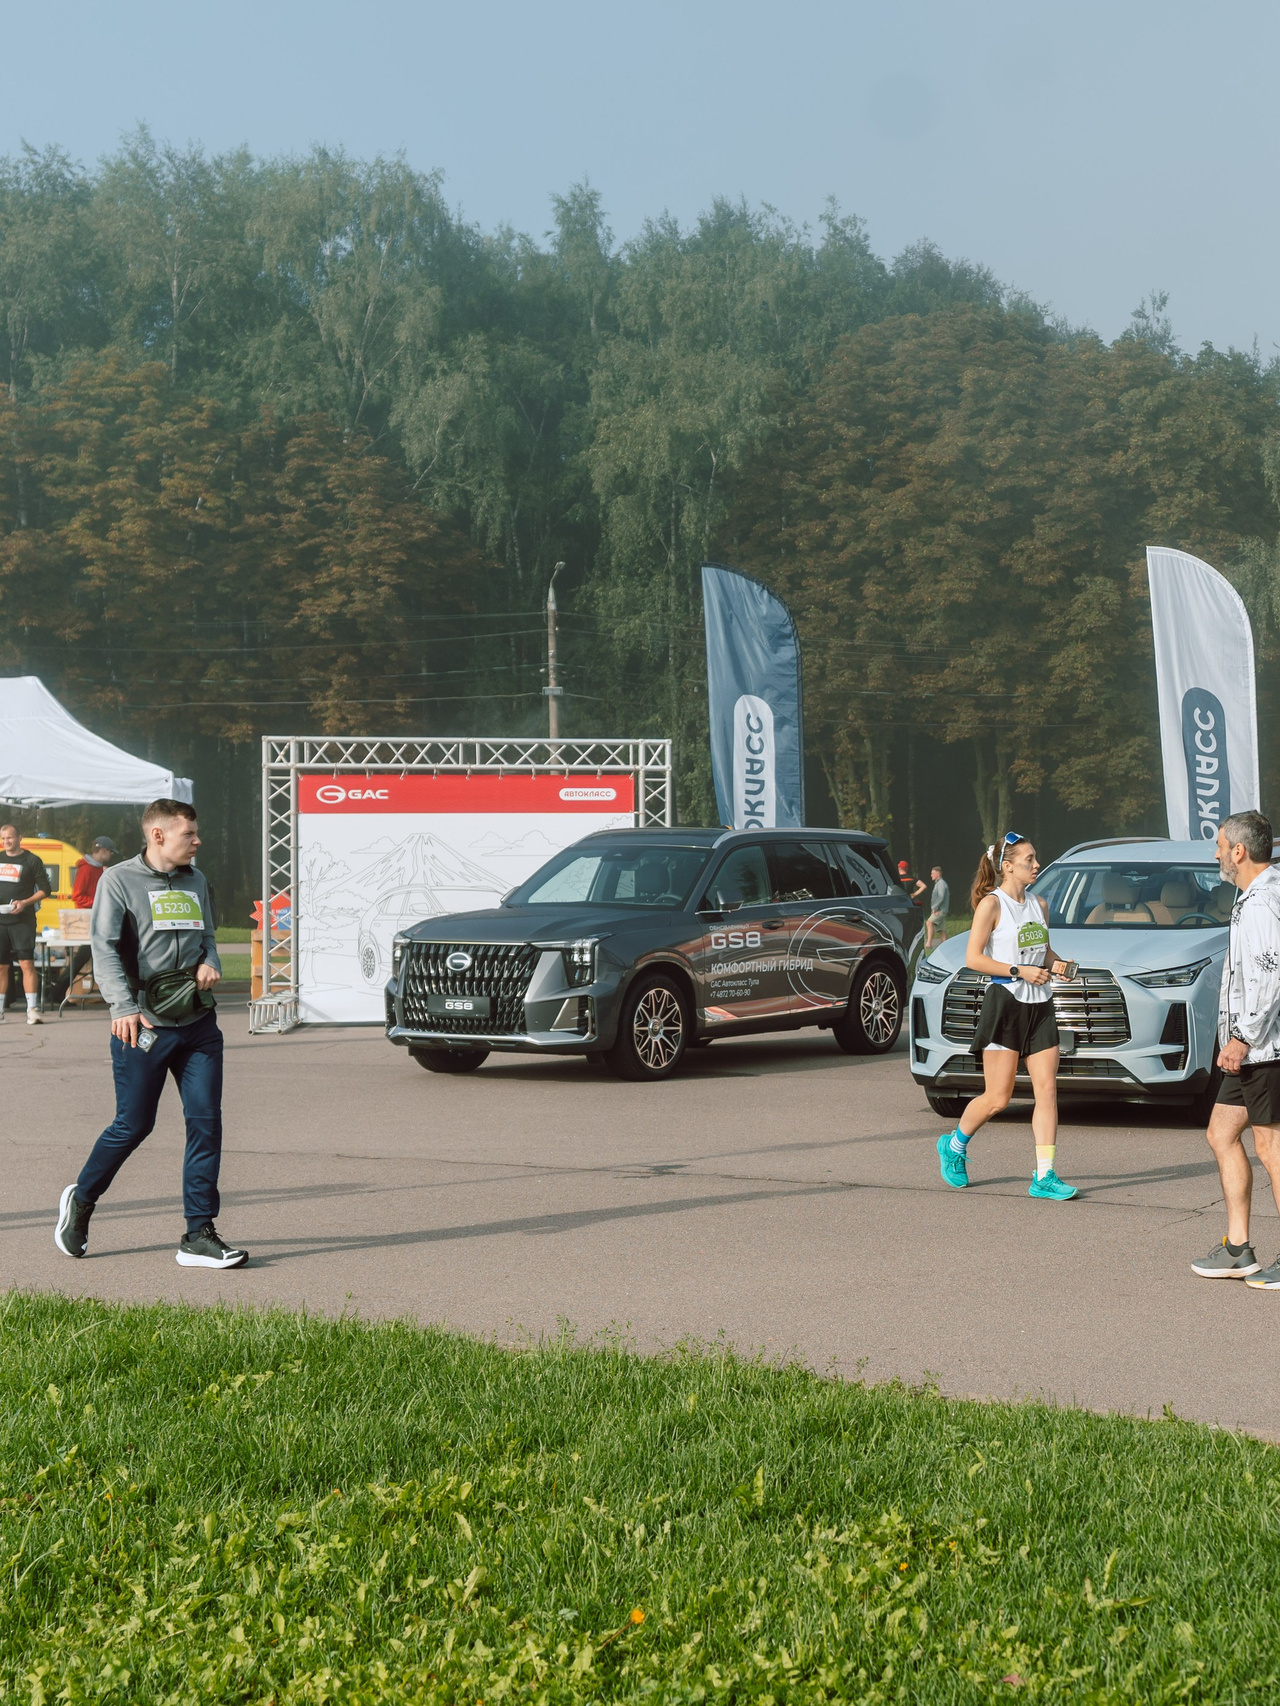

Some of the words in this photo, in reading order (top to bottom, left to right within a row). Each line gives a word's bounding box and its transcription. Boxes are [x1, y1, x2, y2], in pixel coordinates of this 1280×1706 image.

[348, 788, 389, 800] GAC
[564, 790, 611, 798] АВТОКЛАСС
[164, 902, 191, 914] 5230
[711, 931, 761, 950] GS8
[1025, 930, 1044, 941] 5038
[711, 957, 777, 975] КОМФОРТНЫЙ
[778, 958, 814, 972] ГИБРИД
[710, 980, 721, 989] GAC
[445, 1001, 474, 1011] GS8
